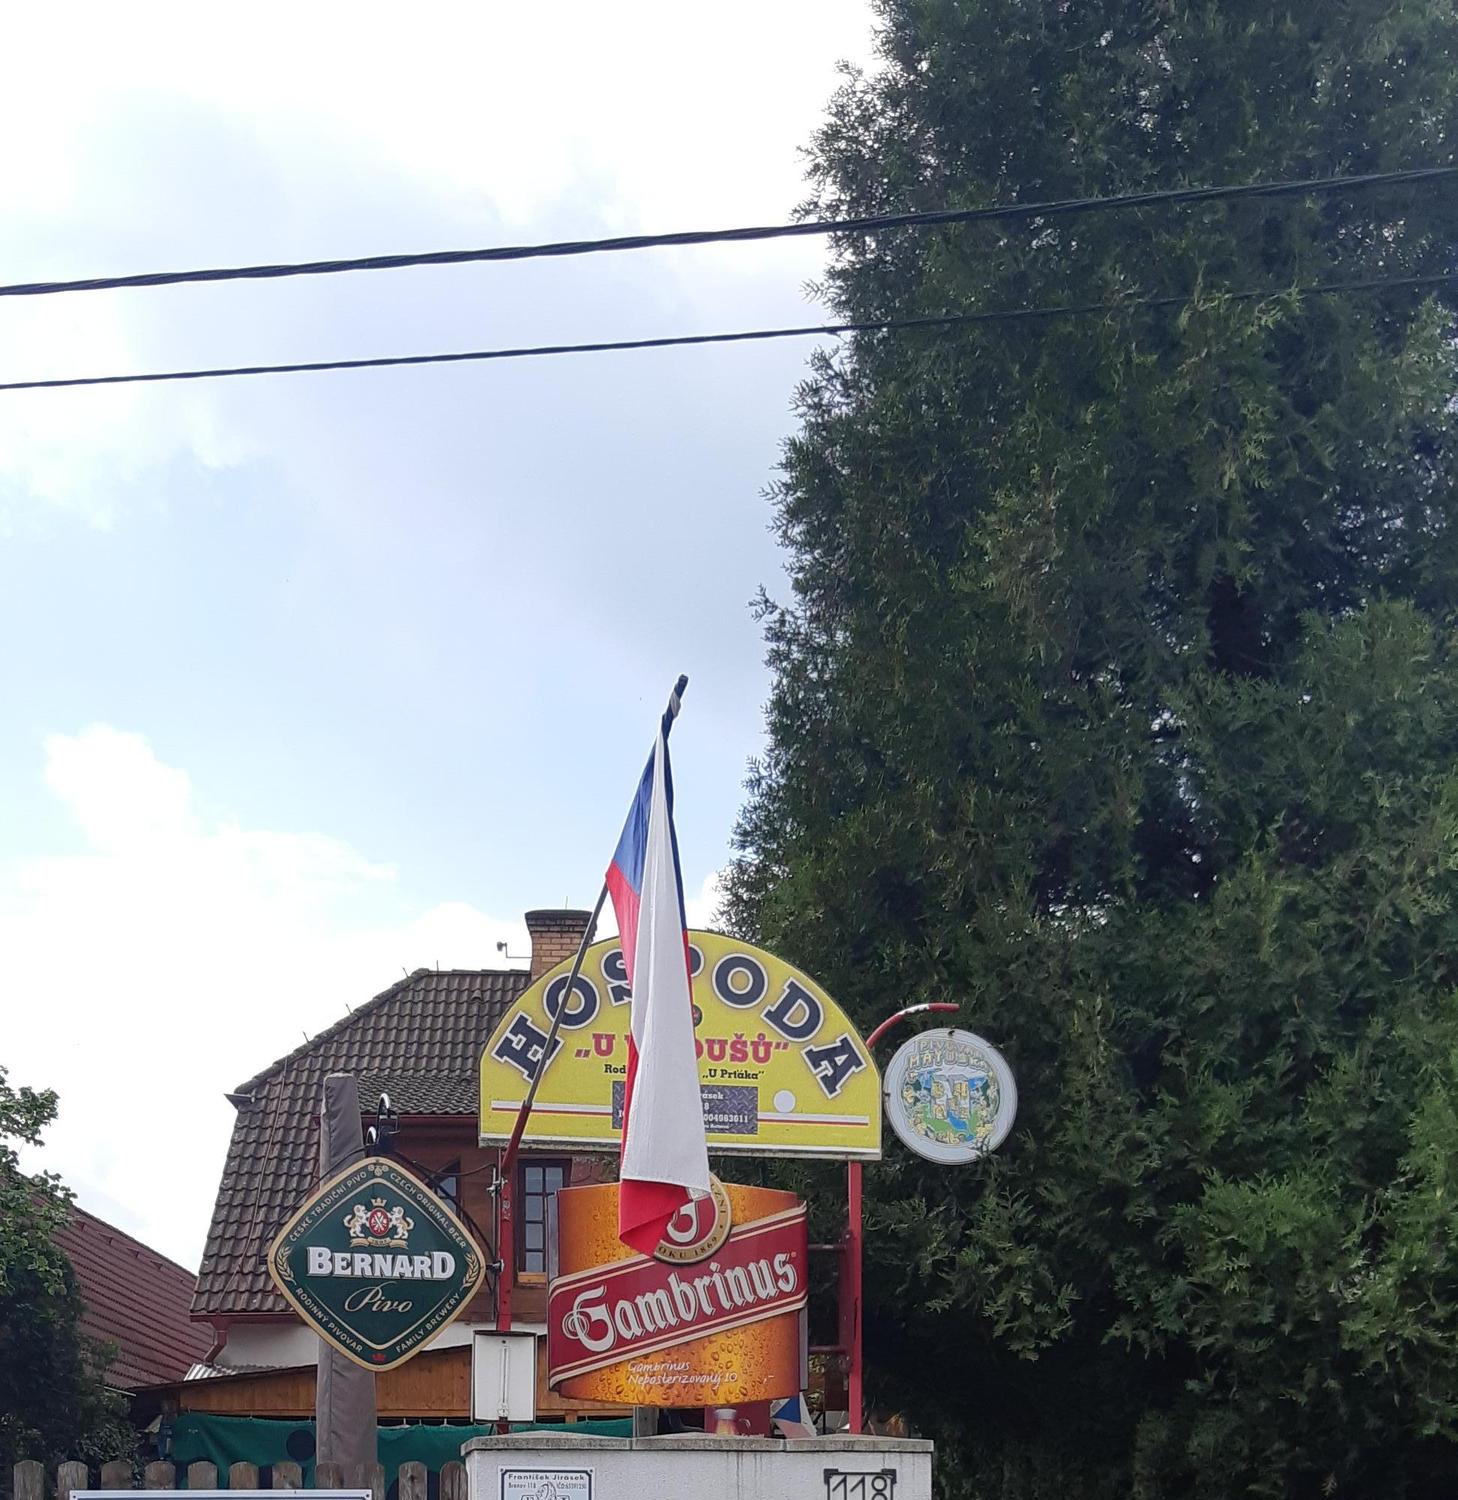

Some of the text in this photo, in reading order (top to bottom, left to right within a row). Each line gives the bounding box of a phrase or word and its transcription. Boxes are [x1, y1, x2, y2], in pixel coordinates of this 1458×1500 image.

[702, 1090, 724, 1100] ásek
[311, 1185, 347, 1217] TRADIČNÍ
[347, 1171, 367, 1188] PIVO
[390, 1172, 467, 1248] CZECH ORIGINAL BEER
[307, 1246, 456, 1280] BERNARD
[658, 1246, 687, 1259] OKU
[344, 1281, 413, 1313] Pivo
[562, 1252, 797, 1352] Gambrinus
[295, 1287, 363, 1353] RODINNÝ PIVOVAR
[395, 1292, 460, 1353] FAMILY BREWERY
[628, 1361, 690, 1372] Gambrinus
